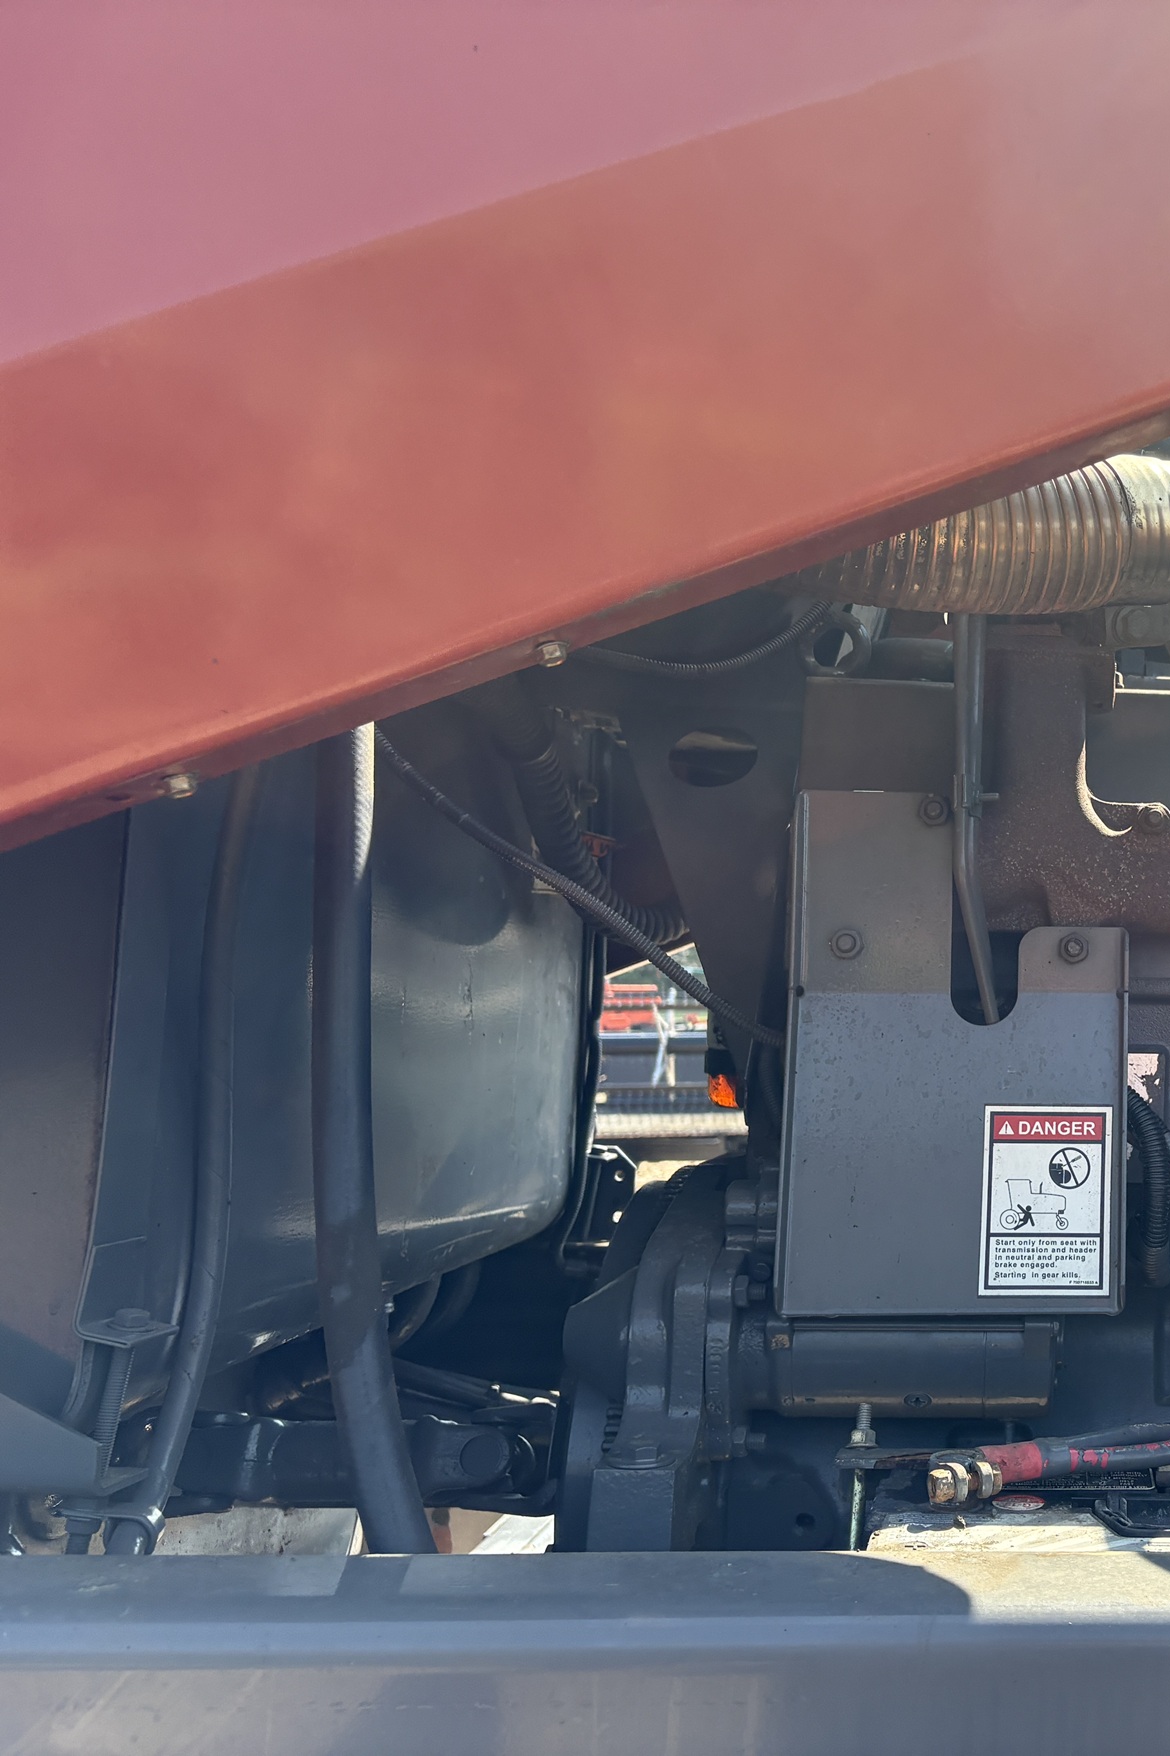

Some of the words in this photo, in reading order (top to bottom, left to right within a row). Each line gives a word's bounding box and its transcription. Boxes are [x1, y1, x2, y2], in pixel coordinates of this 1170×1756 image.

[1018, 1121, 1096, 1136] DANGER
[1018, 1239, 1036, 1247] only
[1055, 1254, 1086, 1262] parking
[994, 1271, 1026, 1279] Starting
[1061, 1271, 1081, 1279] kills.
